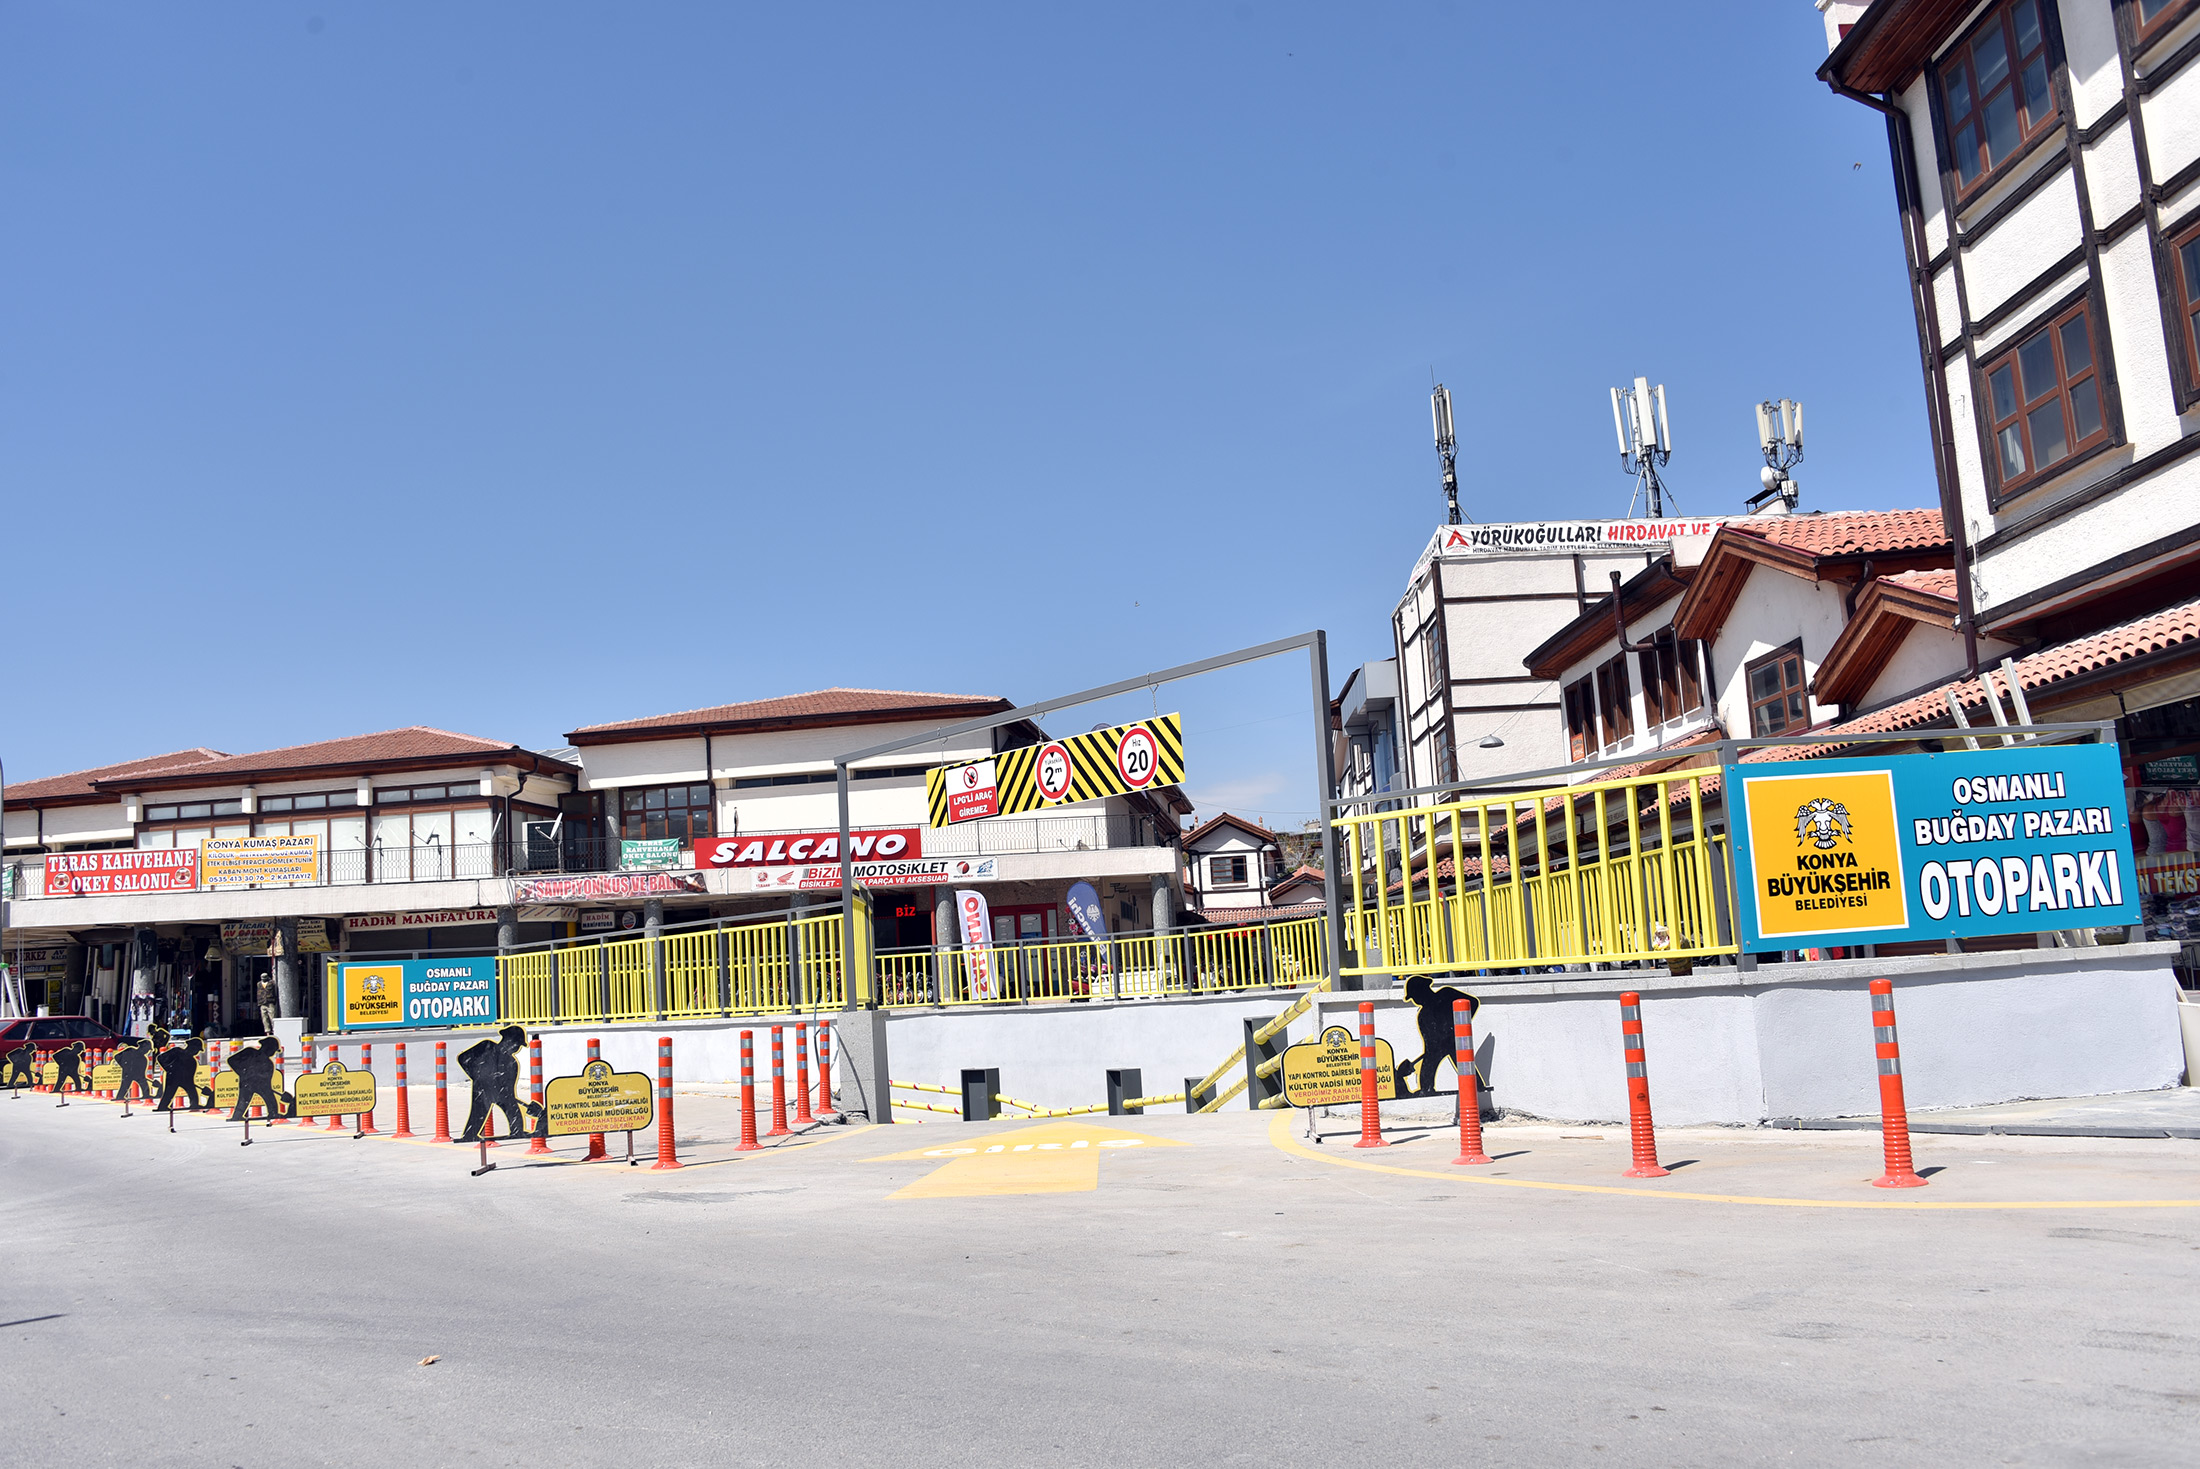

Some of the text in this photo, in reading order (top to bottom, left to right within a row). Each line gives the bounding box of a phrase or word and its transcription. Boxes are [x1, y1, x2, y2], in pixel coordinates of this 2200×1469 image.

[1471, 524, 1601, 545] YÖRÜKOĞULLARI
[1608, 523, 1687, 541] HIRDAVAT
[1127, 749, 1149, 774] 20
[974, 790, 993, 802] ARAÇ
[1952, 771, 2066, 805] OSMANLI
[959, 804, 988, 818] GİREMEZ
[1913, 806, 2113, 846] BUĞDAY PAZARI
[207, 838, 313, 850] KONYA KUMAŞ PAZARI
[709, 834, 907, 864] SALCANO
[48, 850, 195, 873] TERAS KAHVEHANE
[1796, 851, 1858, 871] KONYA
[71, 872, 171, 893] OKEY SALONU
[603, 876, 628, 897] KUŞ
[630, 875, 648, 892] VE
[868, 878, 894, 886] PARÇA
[907, 874, 948, 883] AKSESUAR
[1767, 867, 1891, 897] BÜYÜKŞEHİR
[1919, 849, 2124, 921] OTOPARKI
[1795, 893, 1868, 911] BELEDİYESİ
[426, 967, 472, 978] OSMANLI
[409, 980, 489, 993] BUĞDAY PAZARI
[349, 1000, 398, 1010] BÜYÜKŞEHİR
[409, 995, 490, 1020] OTOPARKI
[1302, 1070, 1330, 1080] KONTROL
[1331, 1068, 1354, 1077] DAİRESİ
[1288, 1081, 1318, 1091] KÜLTÜR
[1319, 1079, 1344, 1088] VADİSİ
[550, 1107, 649, 1120] KÜLTÜR VADİSİ MÜDÜRLÜĞÜ
[564, 1101, 590, 1109] KONTROL
[593, 1115, 645, 1124] RAHATSIZLIKTAN
